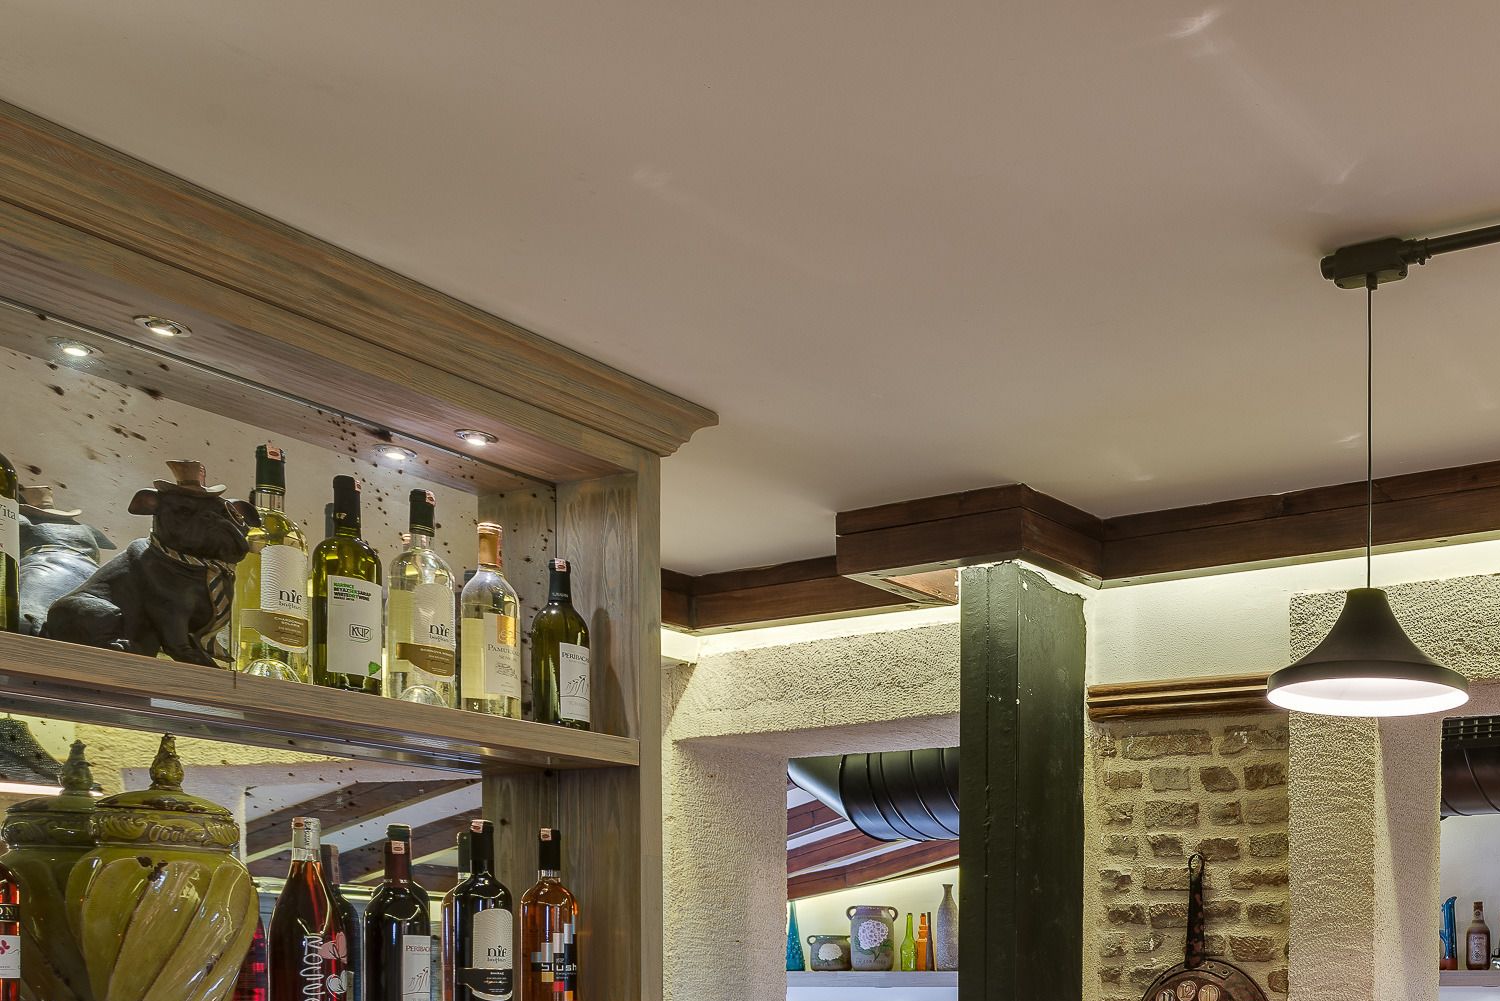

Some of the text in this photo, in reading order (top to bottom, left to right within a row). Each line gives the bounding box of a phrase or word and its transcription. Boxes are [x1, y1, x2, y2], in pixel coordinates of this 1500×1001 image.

[279, 589, 303, 604] nif
[429, 623, 450, 637] nif
[487, 945, 507, 957] nif
